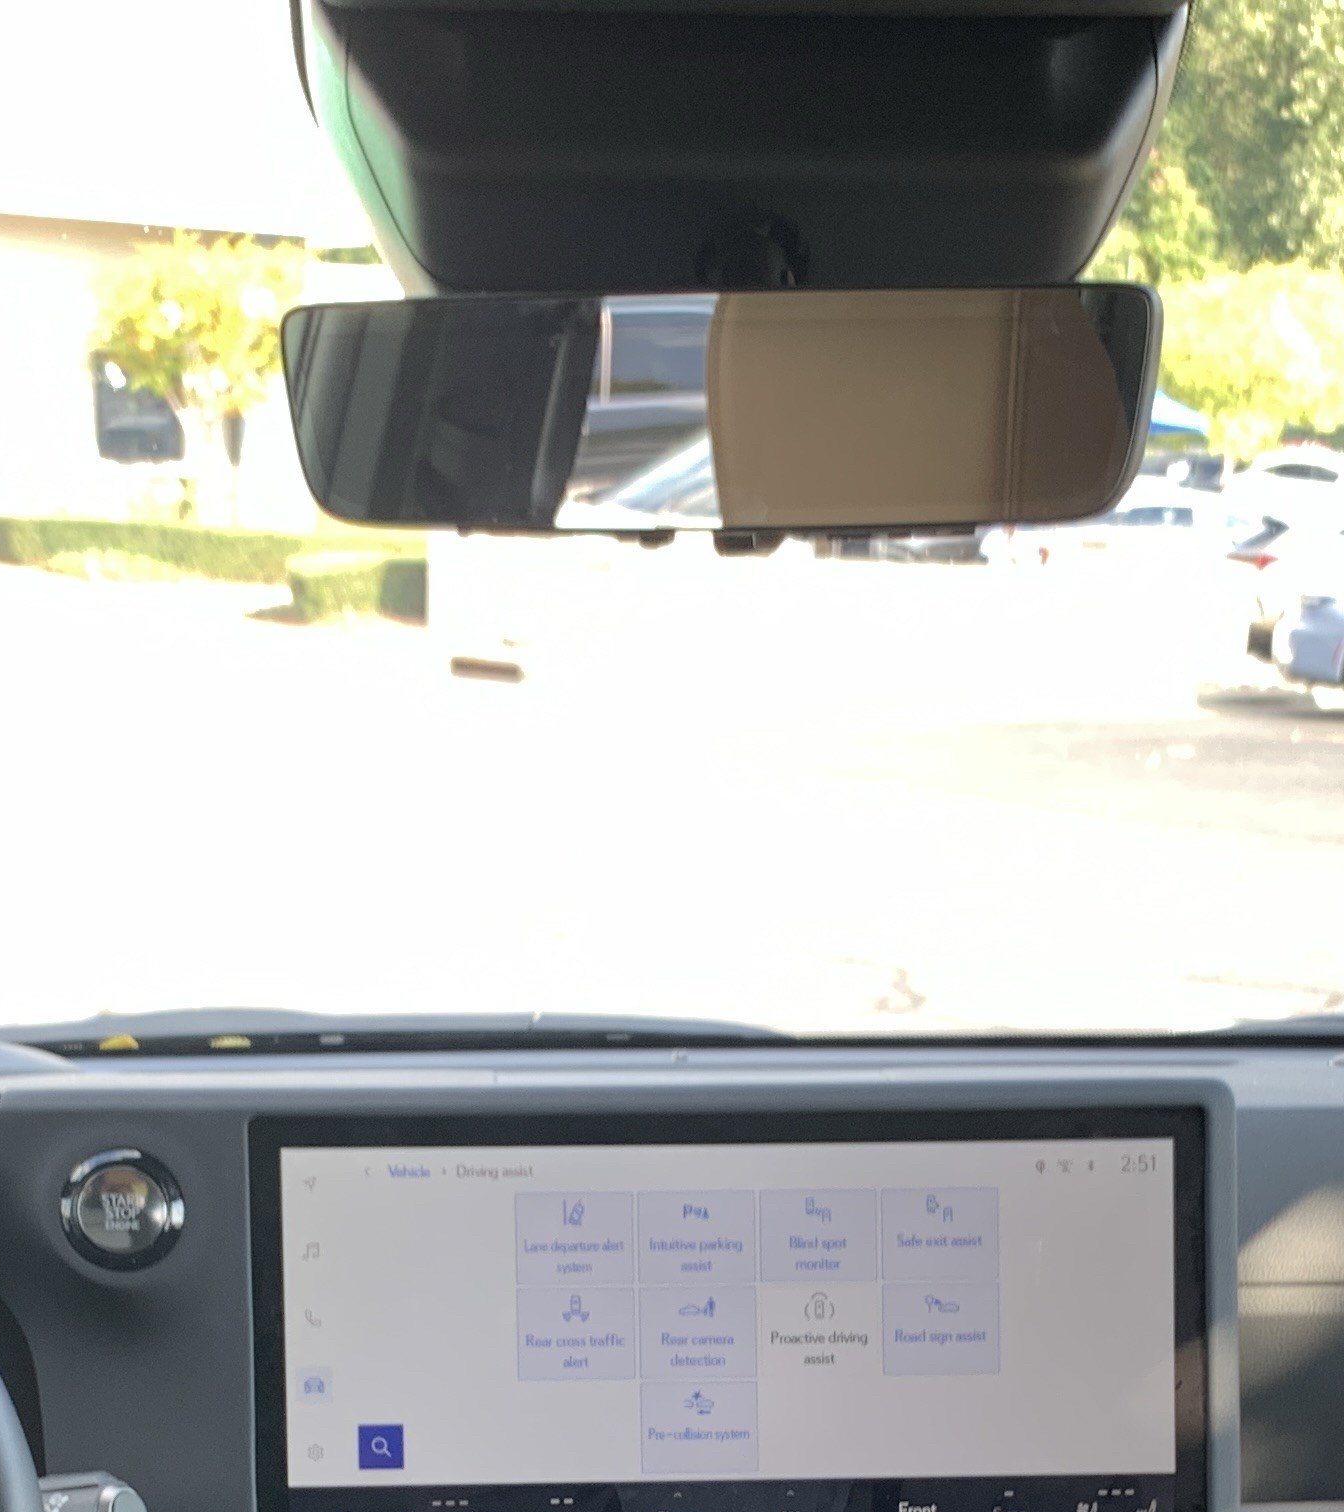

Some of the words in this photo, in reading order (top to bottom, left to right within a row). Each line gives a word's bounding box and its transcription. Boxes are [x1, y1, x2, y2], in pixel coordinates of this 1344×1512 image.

[1121, 1154, 1158, 1174] 2:51
[387, 1164, 431, 1178] Vehicle
[456, 1164, 499, 1179] Driving
[502, 1164, 534, 1178] assist
[524, 1240, 549, 1252] Lane
[550, 1240, 599, 1254] departure
[602, 1239, 624, 1251] alert
[649, 1237, 697, 1250] Intuitive
[699, 1238, 743, 1253] parking
[788, 1236, 822, 1249] Blind
[824, 1237, 847, 1252] spot
[897, 1234, 922, 1247] Safe
[925, 1235, 948, 1247] exit
[950, 1235, 983, 1247] assist
[557, 1262, 593, 1275] system
[680, 1260, 712, 1272] assist
[795, 1259, 841, 1271] monitor
[525, 1334, 552, 1347] Rear
[556, 1336, 586, 1347] cross
[589, 1334, 625, 1346] traffic
[661, 1333, 689, 1345] Rear
[691, 1335, 735, 1346] camera
[770, 1331, 826, 1345] Proactive
[827, 1332, 868, 1347] driving
[894, 1330, 926, 1343] Road
[928, 1330, 951, 1345] sign
[953, 1330, 987, 1342] assist
[563, 1356, 589, 1368] alert
[670, 1355, 725, 1367] detection
[803, 1354, 835, 1365] assist
[648, 1428, 712, 1440] Pre-collision
[715, 1429, 750, 1442] system
